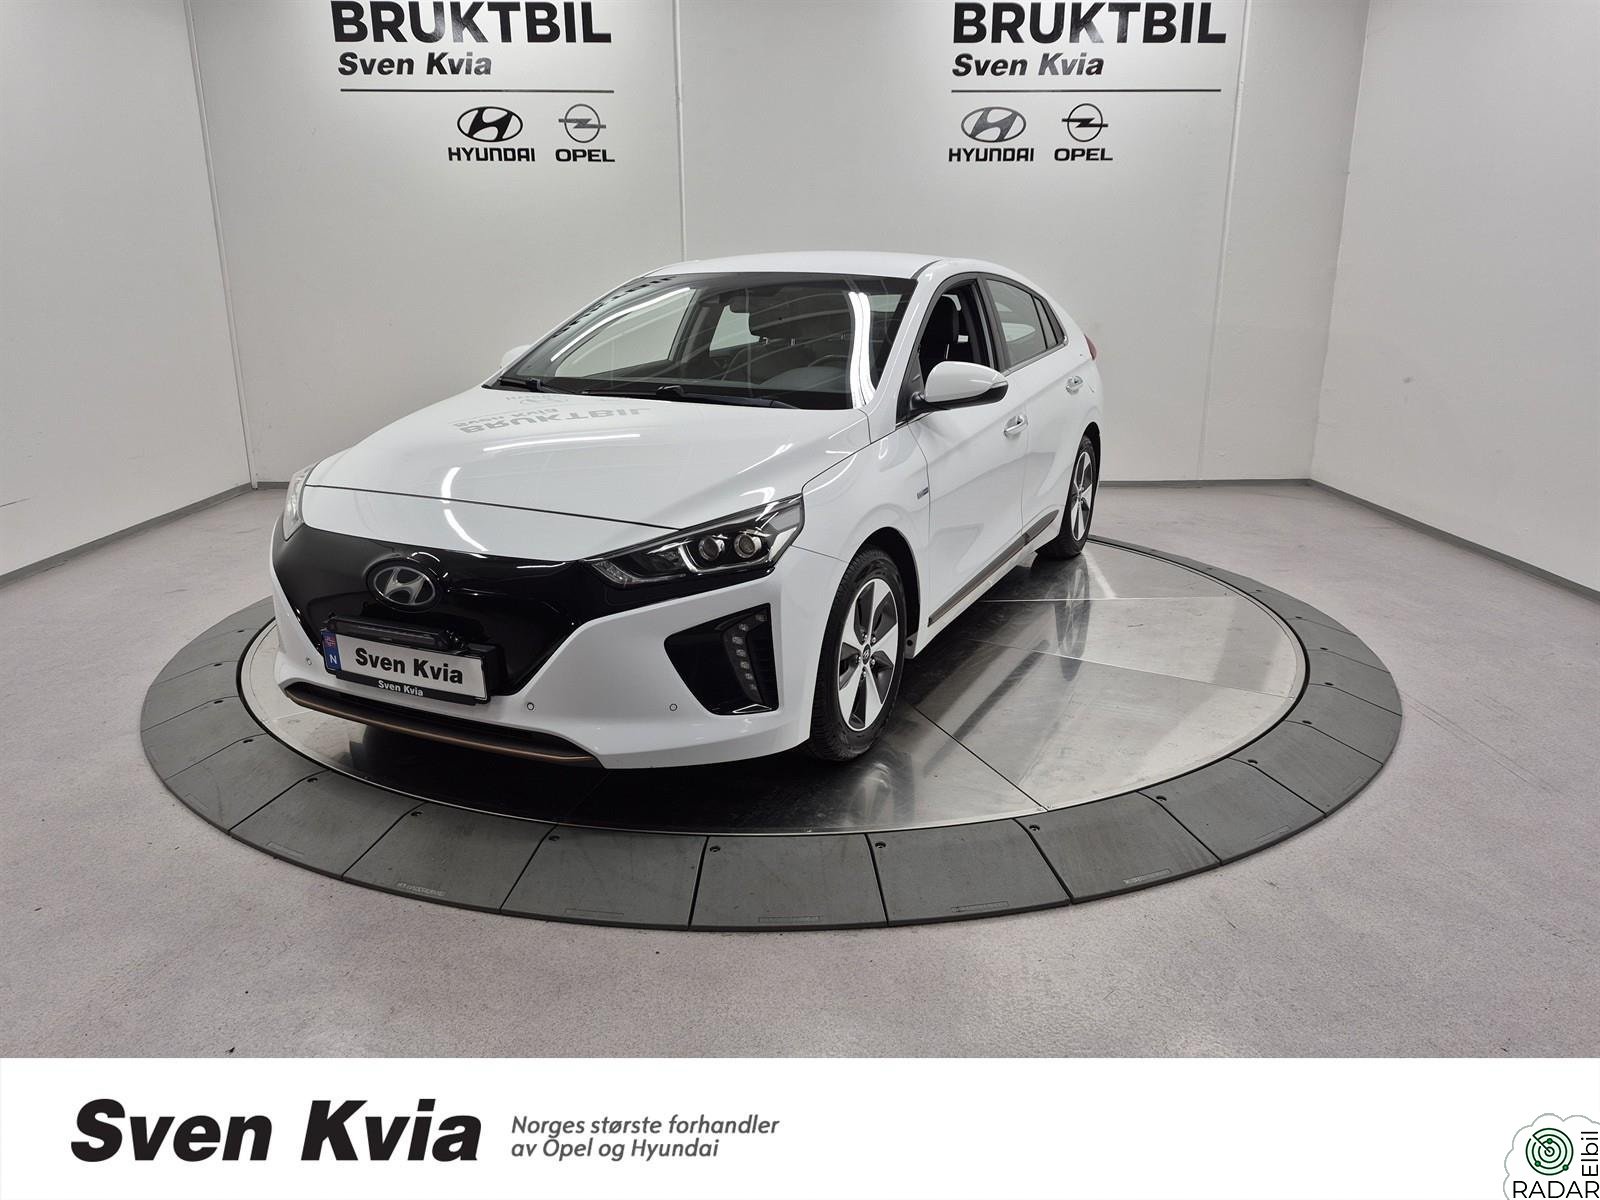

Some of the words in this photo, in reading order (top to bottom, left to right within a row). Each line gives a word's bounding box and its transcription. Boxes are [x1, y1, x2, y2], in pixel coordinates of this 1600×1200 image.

[331, 1, 612, 43] BRUKTBIL
[953, 2, 1227, 43] BRUKTBIL
[338, 51, 415, 75] Sven
[426, 51, 492, 75] Kvia
[952, 53, 1028, 77] Sven
[1038, 52, 1104, 76] Kvia
[448, 147, 536, 162] HYUNDAI
[555, 149, 616, 163] OPEL
[948, 147, 1035, 162] HYUNDAI
[1054, 148, 1114, 161] OPEL
[330, 654, 338, 665] N
[355, 647, 406, 674] Sven
[413, 658, 463, 685] Kvia
[378, 680, 401, 692] Sven
[403, 685, 424, 697] Kvia
